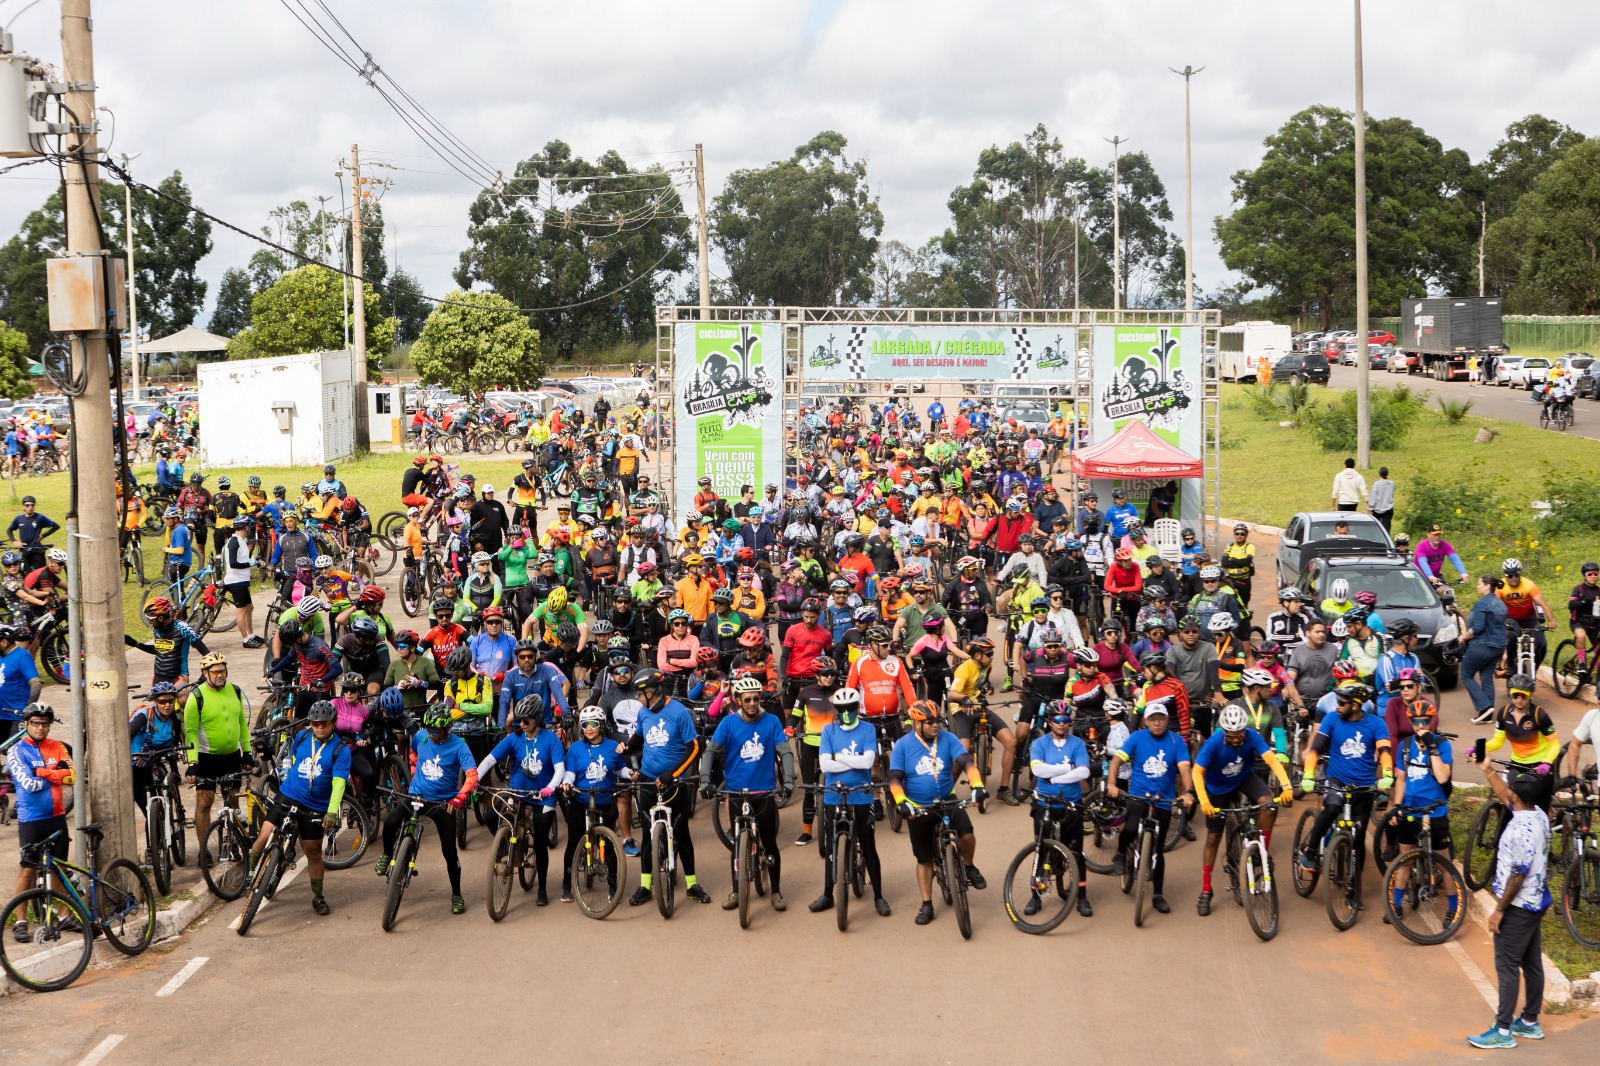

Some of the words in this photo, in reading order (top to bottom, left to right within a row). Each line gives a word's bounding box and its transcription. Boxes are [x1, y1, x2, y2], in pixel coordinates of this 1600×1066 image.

[872, 340, 932, 355] LARGADA
[934, 340, 941, 355] /
[944, 340, 1005, 356] CHEGADA
[892, 358, 911, 367] AQUI,
[913, 358, 924, 367] SEU
[926, 358, 954, 367] DESAFIO
[726, 388, 756, 400] BIKE
[727, 393, 758, 407] CAMP
[1144, 391, 1175, 403] BIKE
[1145, 396, 1176, 411] CAMP
[700, 424, 722, 434] FEITO
[704, 450, 728, 461] Vem
[731, 451, 755, 461] com
[704, 460, 712, 473] a
[716, 460, 755, 474] gente
[1096, 464, 1192, 474] www.SportTimer.combr
